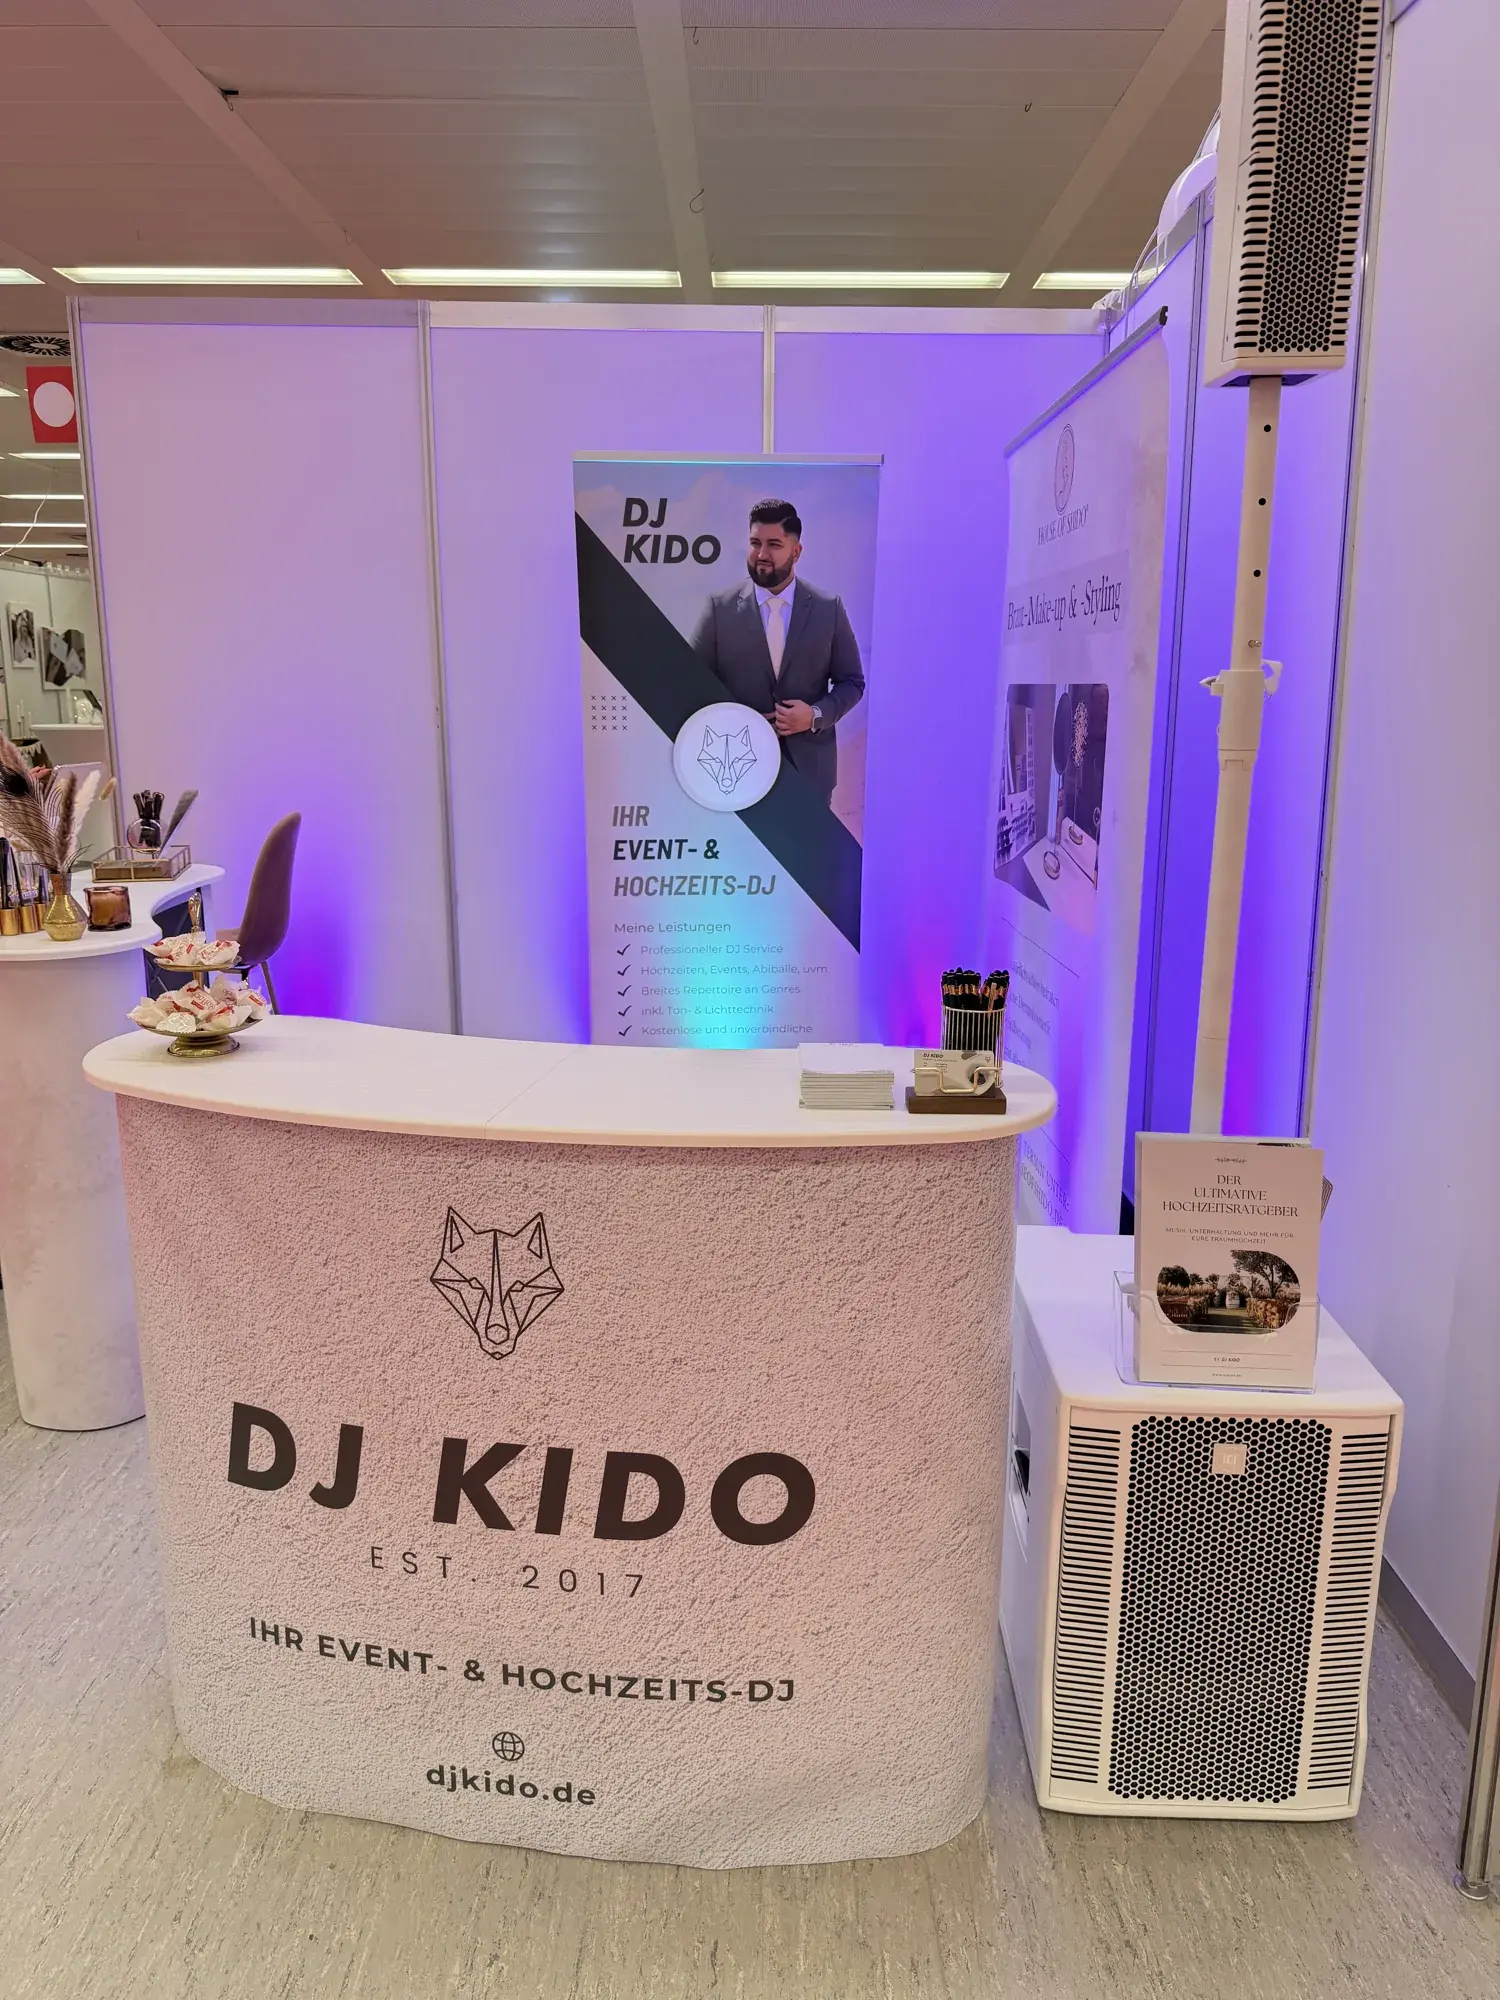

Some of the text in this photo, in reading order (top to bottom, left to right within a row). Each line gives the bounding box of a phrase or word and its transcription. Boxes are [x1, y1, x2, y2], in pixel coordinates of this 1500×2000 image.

[623, 497, 667, 528] DJ
[623, 534, 721, 565] KIDO
[1069, 585, 1077, 618] &
[1081, 575, 1122, 626] -Styling
[612, 805, 650, 827] IHR
[613, 839, 720, 860] EVENT- &
[614, 875, 776, 896] HOCHZEITS-DJ
[614, 922, 731, 935] Meine Leistungen
[640, 945, 783, 955] Professioneller DJ Service
[641, 966, 707, 976] Hochzeiten,
[710, 965, 750, 975] Events,
[803, 966, 830, 974] uvm.
[641, 986, 680, 996] Breites
[683, 985, 741, 996] Repertoire
[761, 985, 800, 994] Genres
[641, 1005, 774, 1016] inkl. Ton- & Lichttechnik
[642, 1024, 813, 1035] Kostenlose und unverbindliche
[1217, 1174, 1241, 1186] DER
[1194, 1187, 1267, 1200] ULTIMATIVE
[1162, 1200, 1299, 1217] HOCHZEITSRATGEBER
[1189, 1228, 1242, 1236] UNTERHALTUNG
[1211, 1236, 1266, 1244] TRAUMHOCHZEIT
[227, 1401, 816, 1546] DJ KIDO
[370, 1546, 643, 1598] EST. 2017
[250, 1616, 795, 1702] IHR EVENT- & HOCHZEITS-DJ
[426, 1764, 596, 1806] djkido.de
